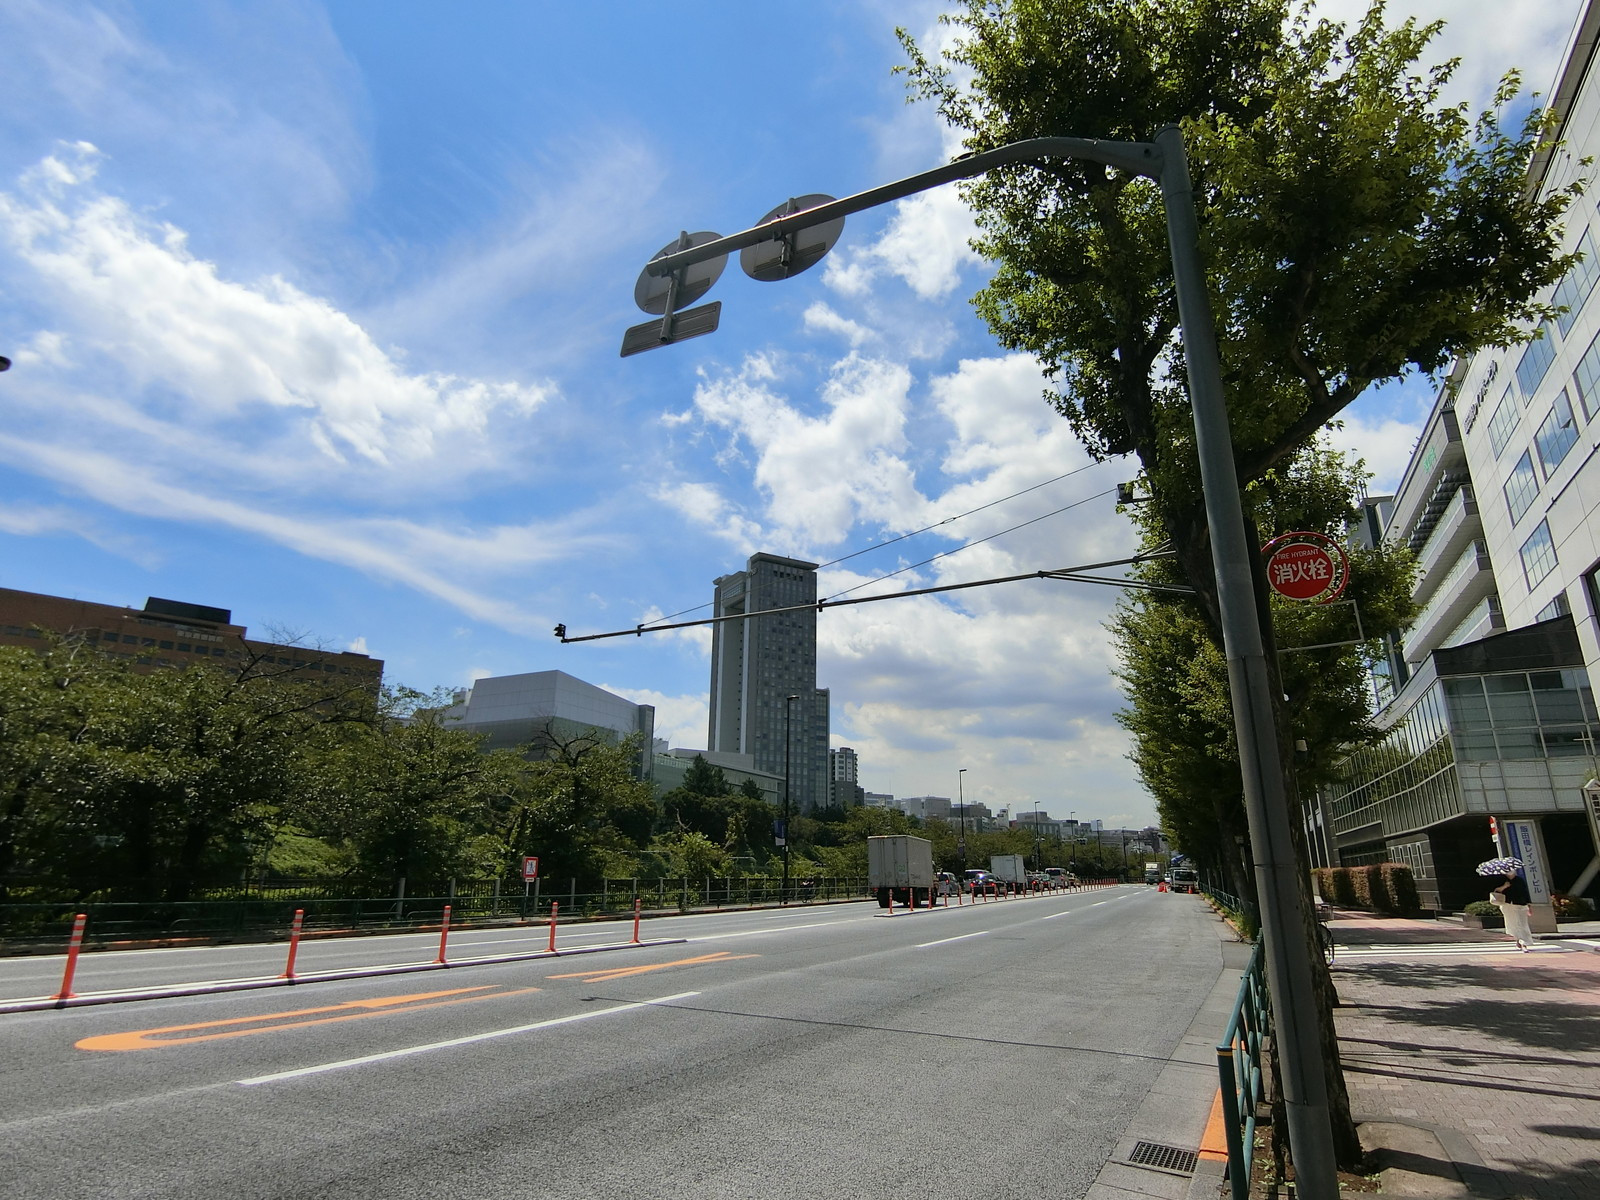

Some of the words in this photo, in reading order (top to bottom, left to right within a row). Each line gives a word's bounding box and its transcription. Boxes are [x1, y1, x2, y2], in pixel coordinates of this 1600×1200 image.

[1291, 549, 1319, 558] HYDRANT
[1273, 557, 1329, 585] 消火栓
